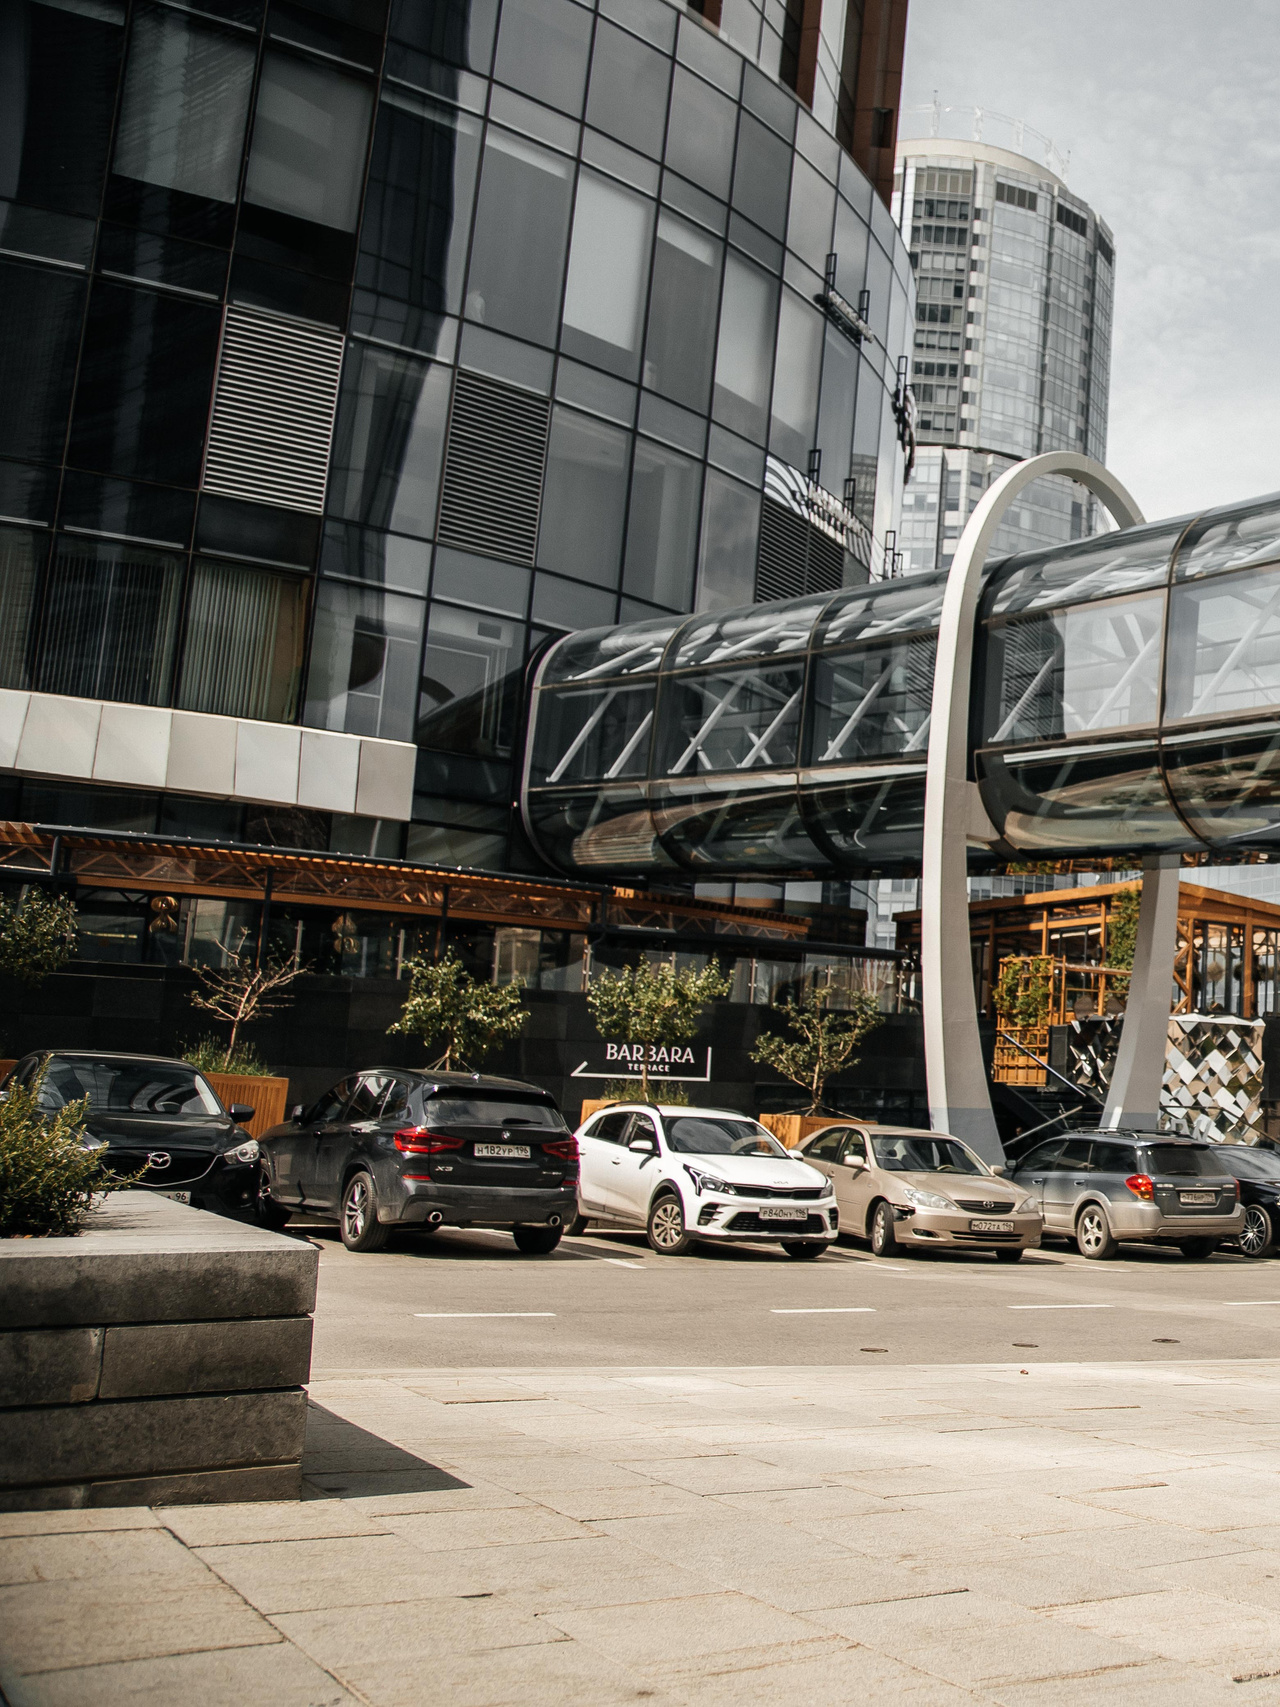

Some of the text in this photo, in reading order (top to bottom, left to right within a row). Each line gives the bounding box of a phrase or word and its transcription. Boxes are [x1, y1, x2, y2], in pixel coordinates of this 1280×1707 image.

[606, 1043, 695, 1063] BARBARA
[477, 1145, 529, 1156] Н182УР 196
